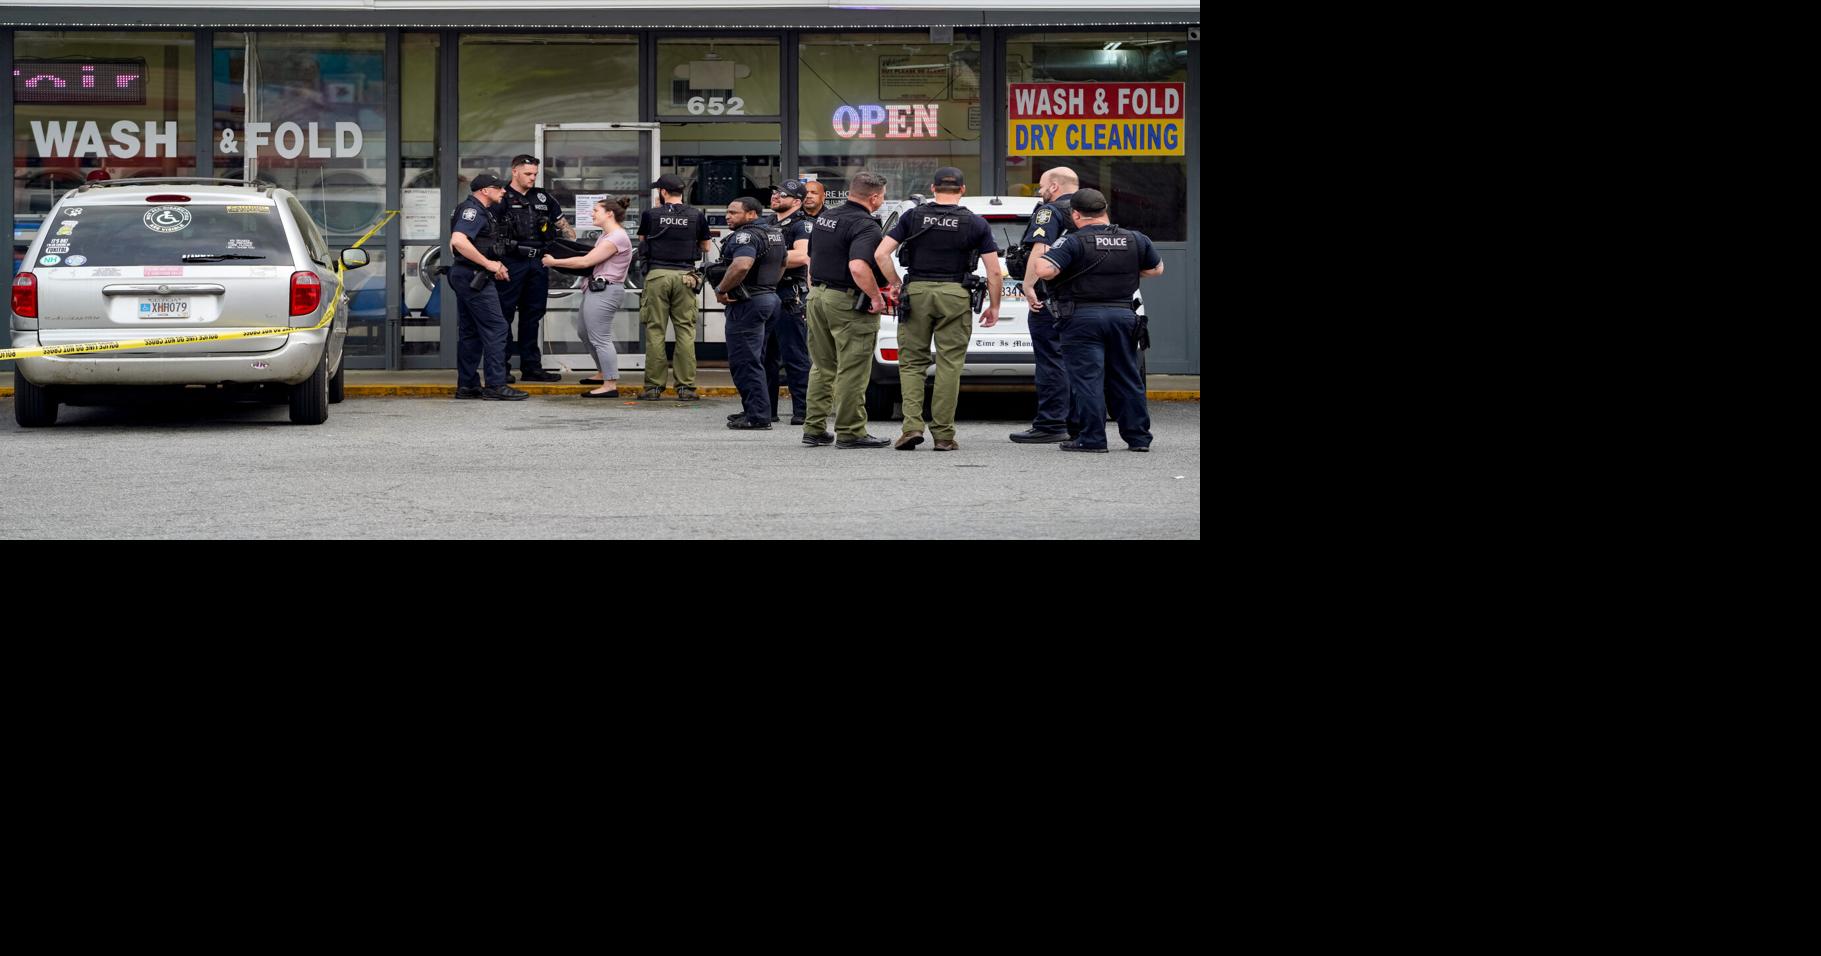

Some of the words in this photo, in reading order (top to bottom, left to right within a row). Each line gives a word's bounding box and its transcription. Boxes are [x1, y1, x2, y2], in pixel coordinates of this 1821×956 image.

[687, 96, 745, 116] 652
[1015, 88, 1084, 115] WASH
[1093, 88, 1110, 115] &
[1118, 88, 1180, 115] FOLD
[832, 104, 939, 138] OPEN
[30, 120, 177, 159] WASH
[219, 128, 239, 154] &
[248, 121, 363, 160] FOLD
[1015, 124, 1058, 150] DRY
[1066, 123, 1178, 150] CLEANING
[660, 217, 688, 226] POLICE
[816, 216, 837, 229] POLICE
[923, 216, 959, 228] POLICE
[1096, 237, 1127, 247] POLICE
